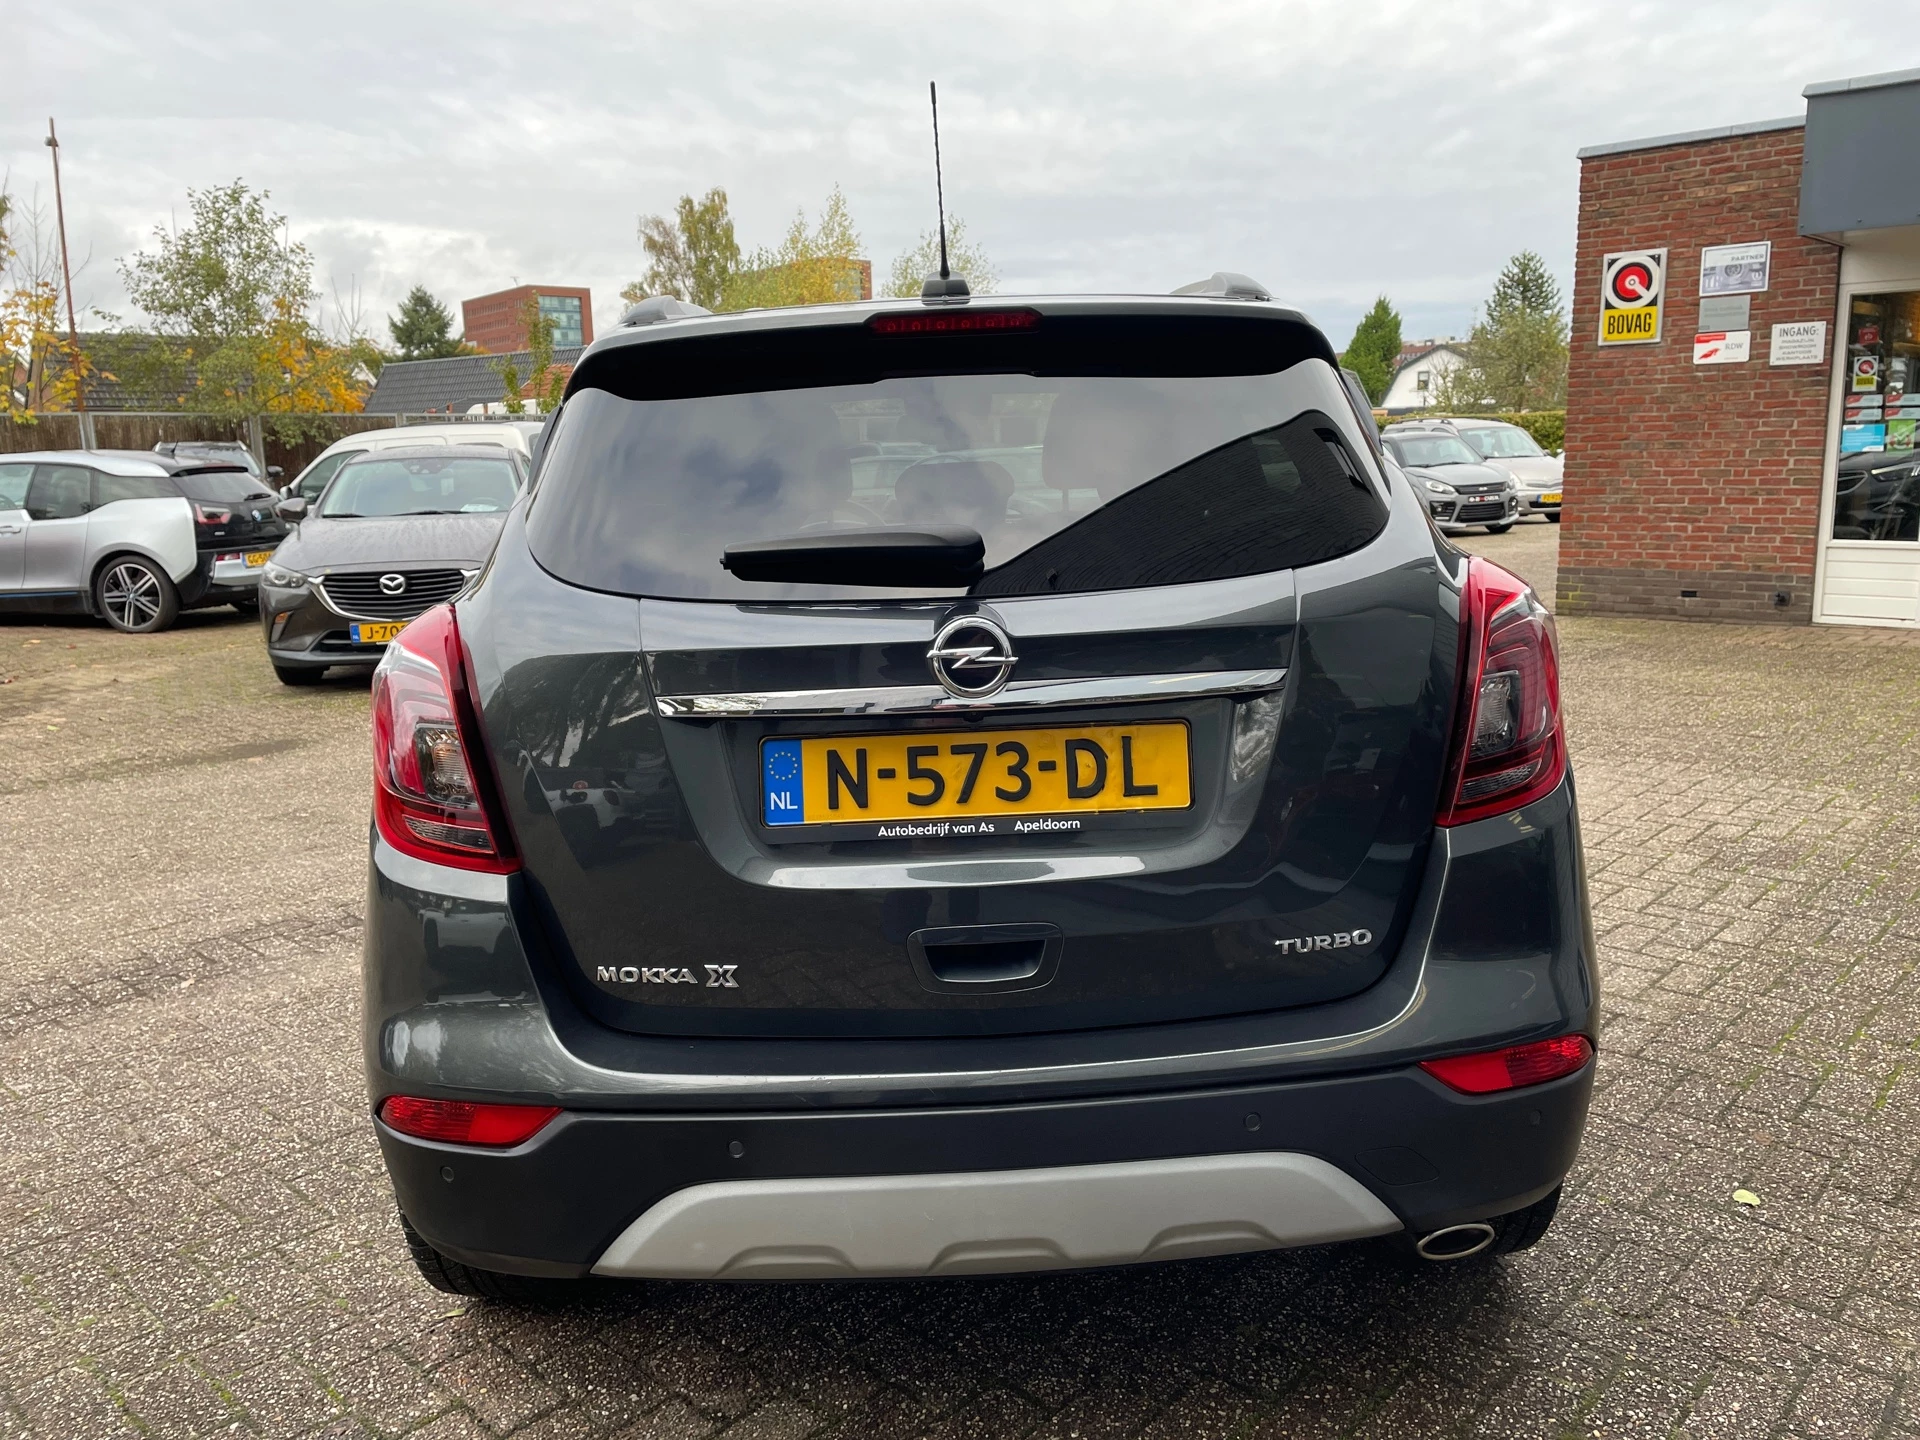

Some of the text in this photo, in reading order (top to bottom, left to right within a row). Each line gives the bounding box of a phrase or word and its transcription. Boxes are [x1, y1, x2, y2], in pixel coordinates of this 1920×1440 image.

[1731, 253, 1765, 262] PARTNER
[1607, 312, 1652, 335] BOVAG
[1779, 325, 1819, 337] INGANG:
[1725, 342, 1744, 350] RDW
[366, 624, 406, 640] J-70
[826, 735, 1159, 810] N-573-DL
[770, 791, 799, 811] NL
[877, 818, 1081, 837] Autobedrijf van As Apeldoorn
[1274, 928, 1372, 955] TURBO
[597, 964, 740, 988] MOKKA X
